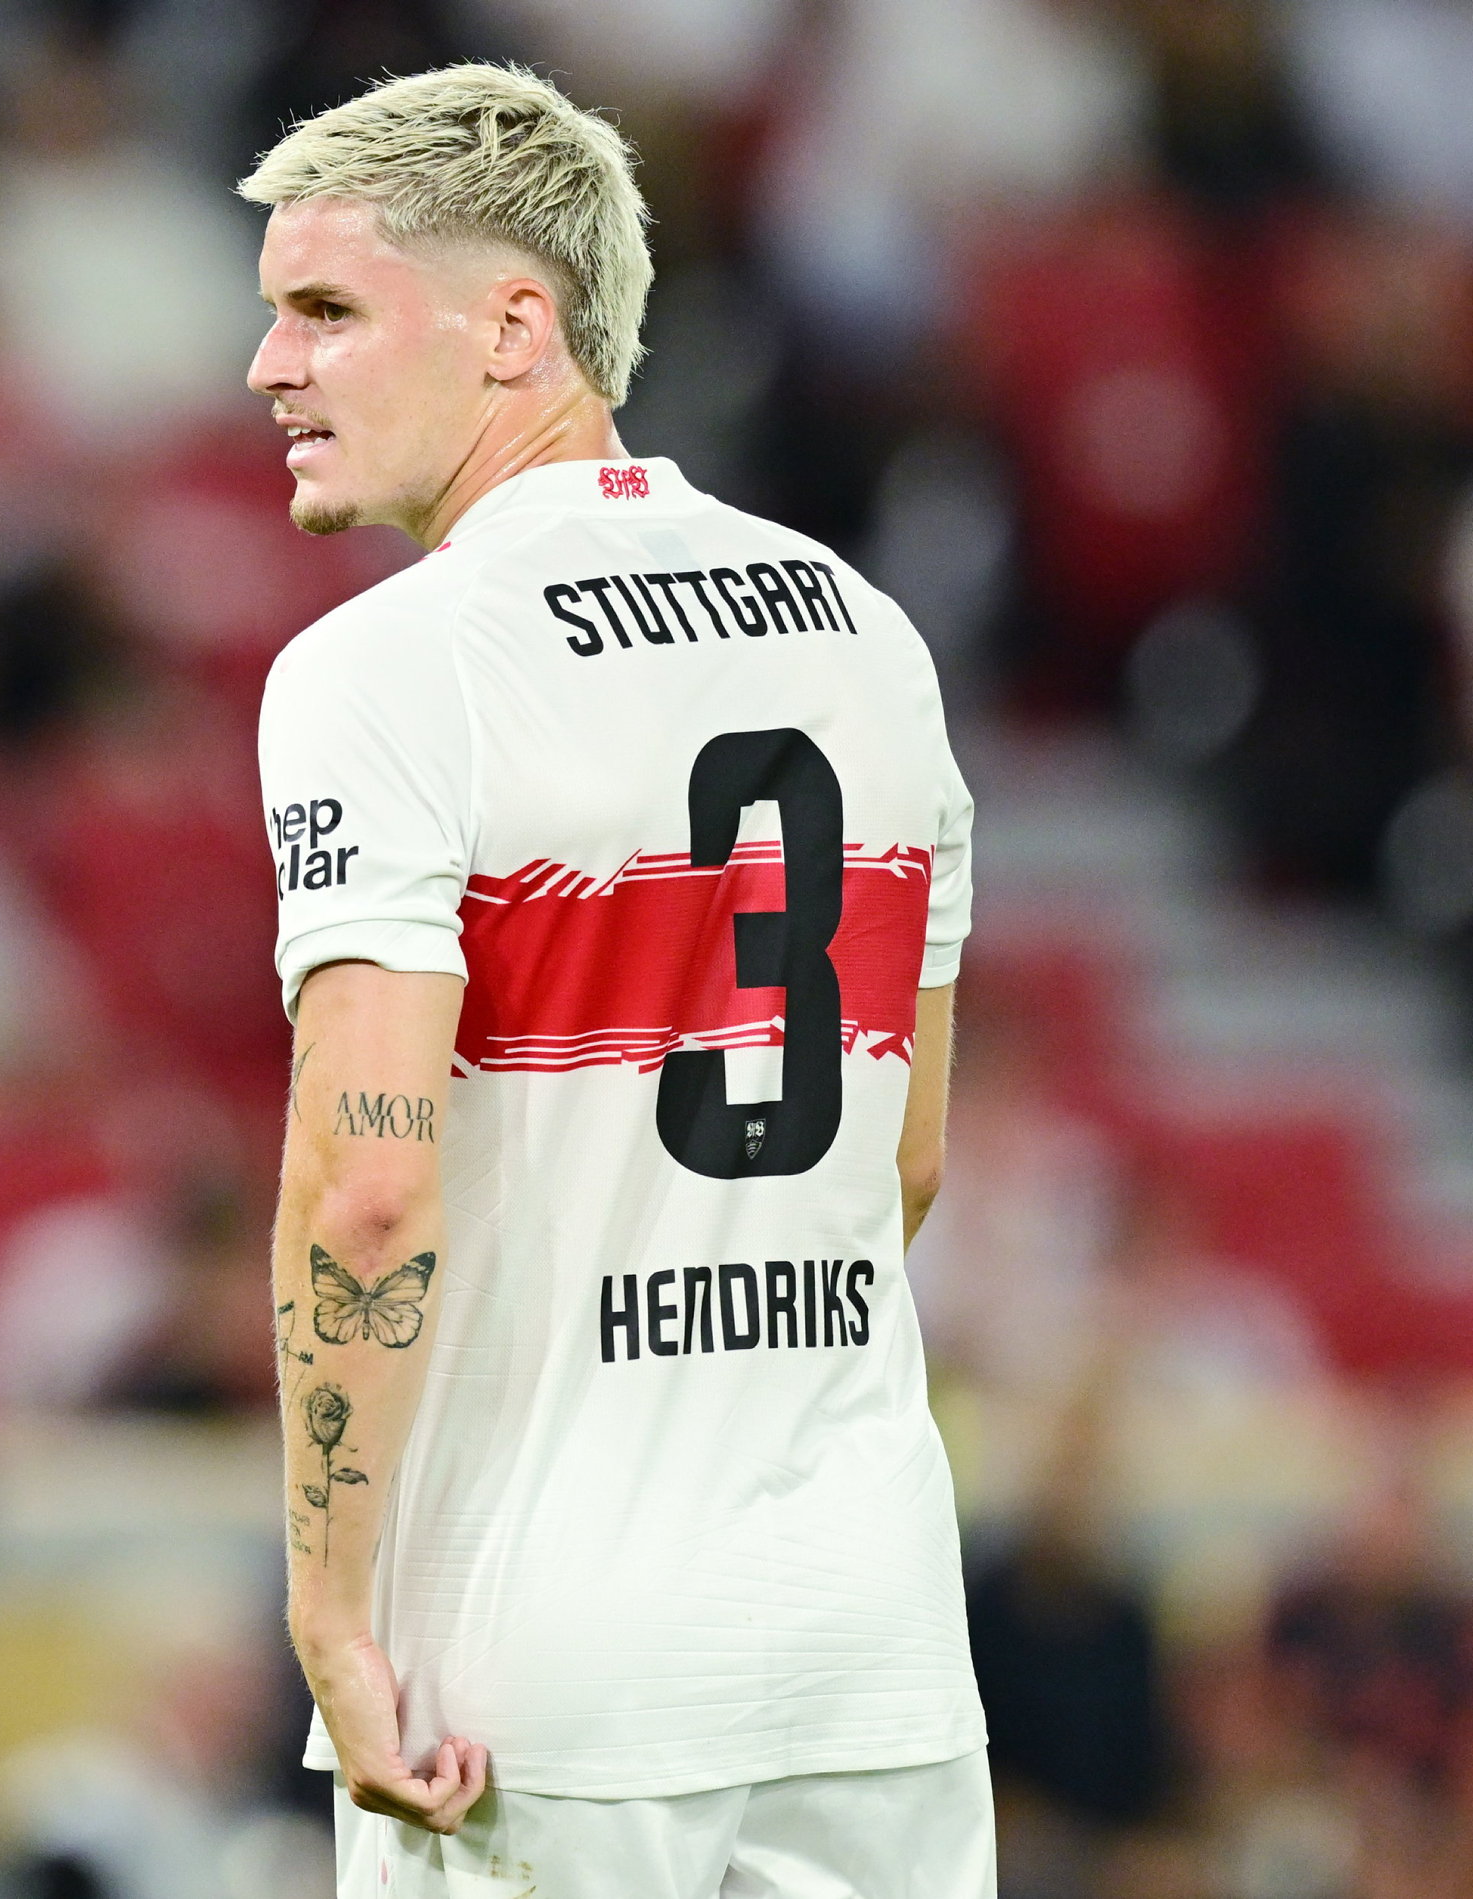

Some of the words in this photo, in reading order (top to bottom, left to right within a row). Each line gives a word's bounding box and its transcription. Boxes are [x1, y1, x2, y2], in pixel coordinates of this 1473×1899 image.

[543, 559, 858, 657] STUTTGART
[656, 727, 843, 1179] 3
[333, 1091, 434, 1144] AMOR
[601, 1259, 875, 1363] HENDRIKS
